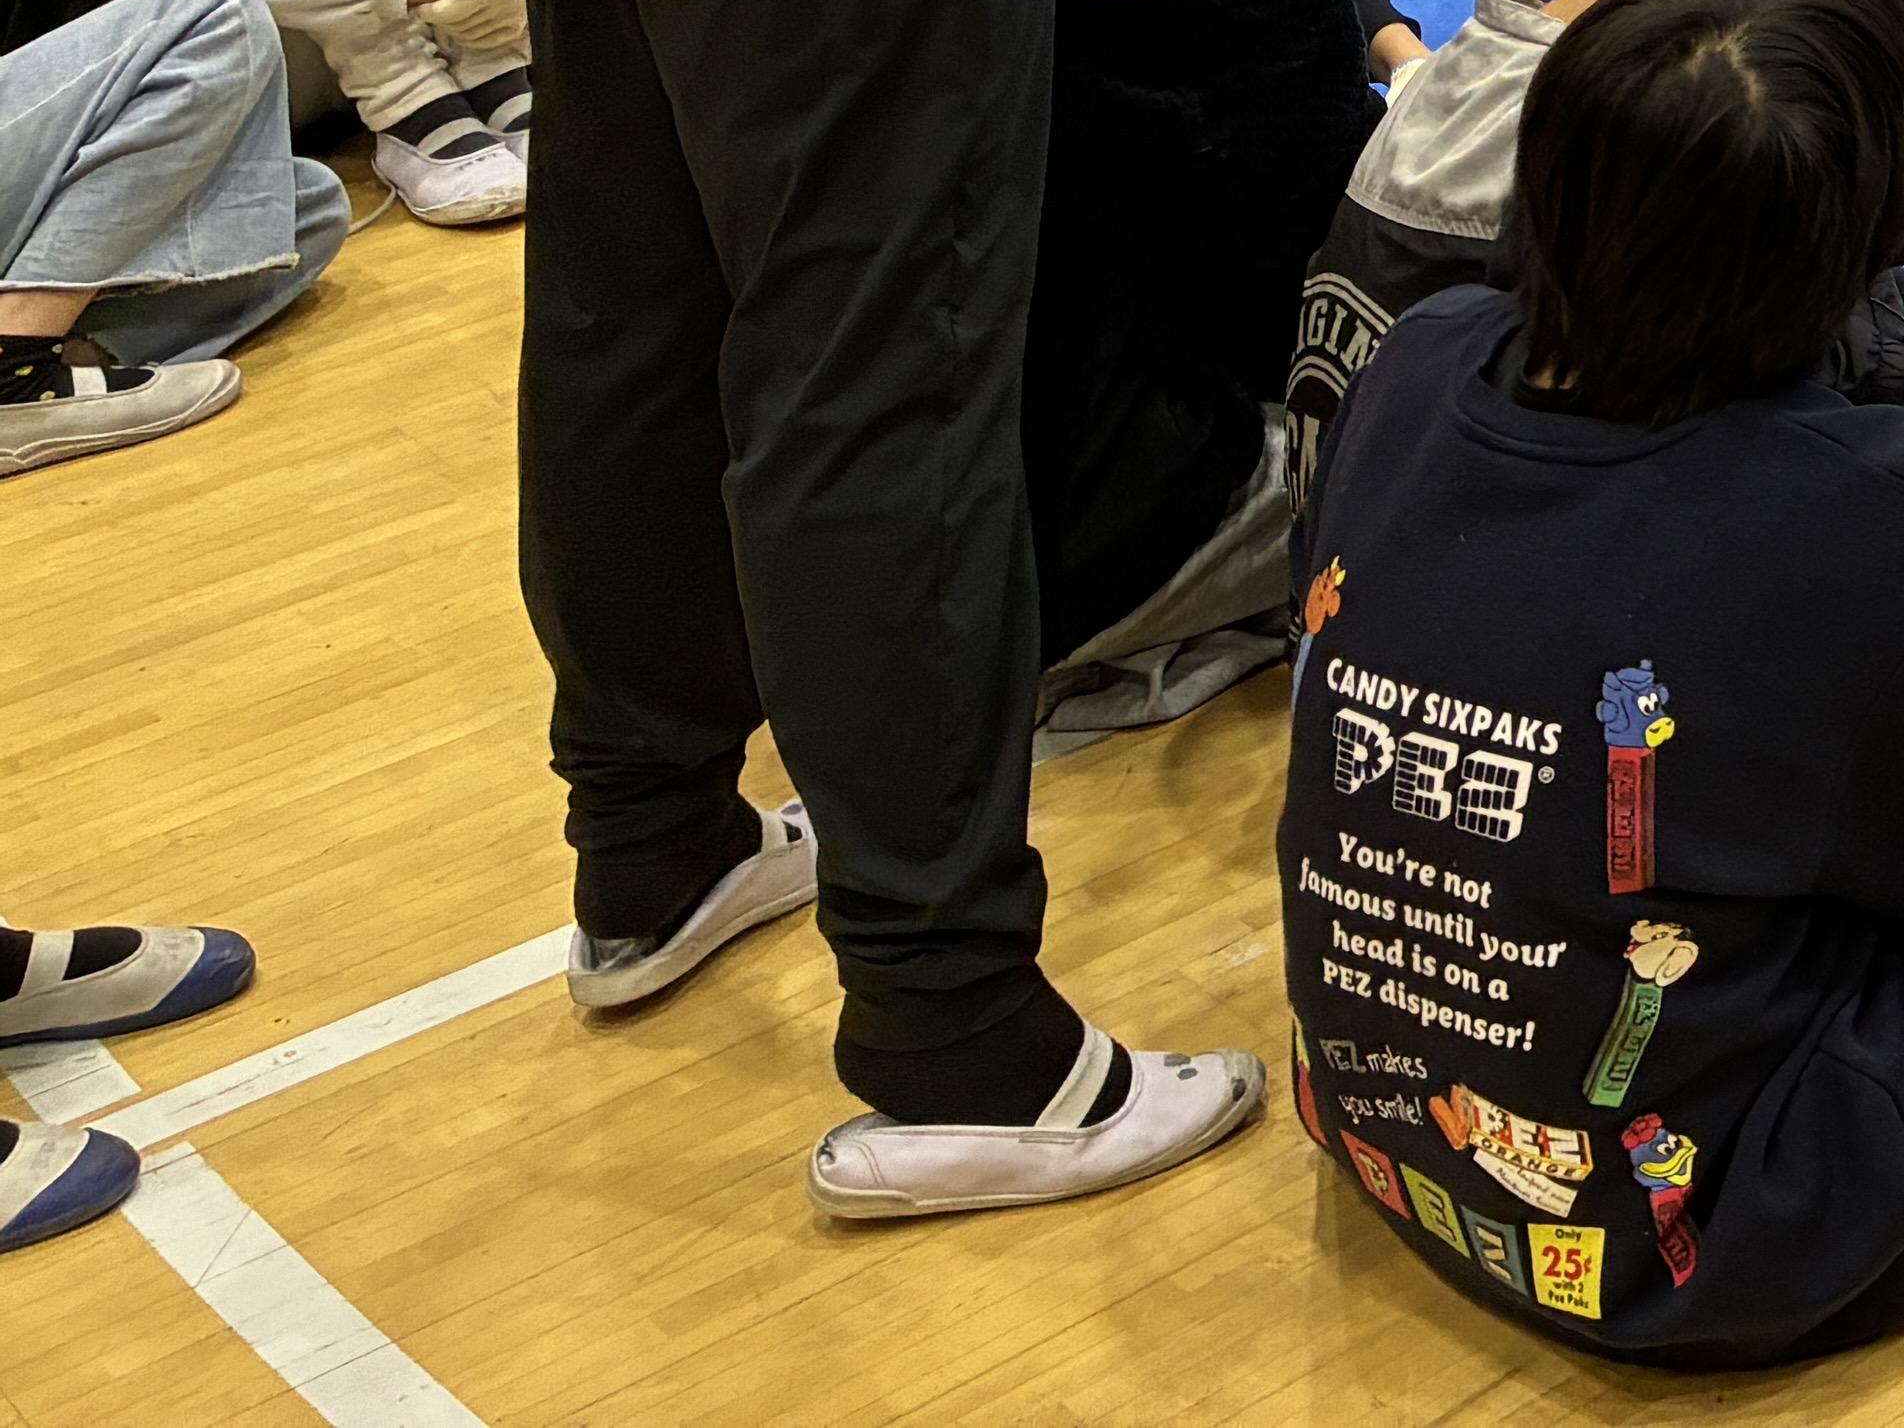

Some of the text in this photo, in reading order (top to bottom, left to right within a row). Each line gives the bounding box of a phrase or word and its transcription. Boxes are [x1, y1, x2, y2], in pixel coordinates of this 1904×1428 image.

[1326, 657, 1563, 755] CANDY SIXPAKS
[1332, 707, 1534, 843] PEZ
[1339, 831, 1493, 909] You're not
[1299, 856, 1567, 968] famous until your
[1332, 919, 1510, 1002] head is on a
[1322, 956, 1536, 1052] PEZ dispenser!
[1366, 1044, 1428, 1080] makes
[1338, 1092, 1424, 1126] you smile!
[1481, 1137, 1577, 1177] ORANGE
[1555, 1228, 1582, 1243] Only
